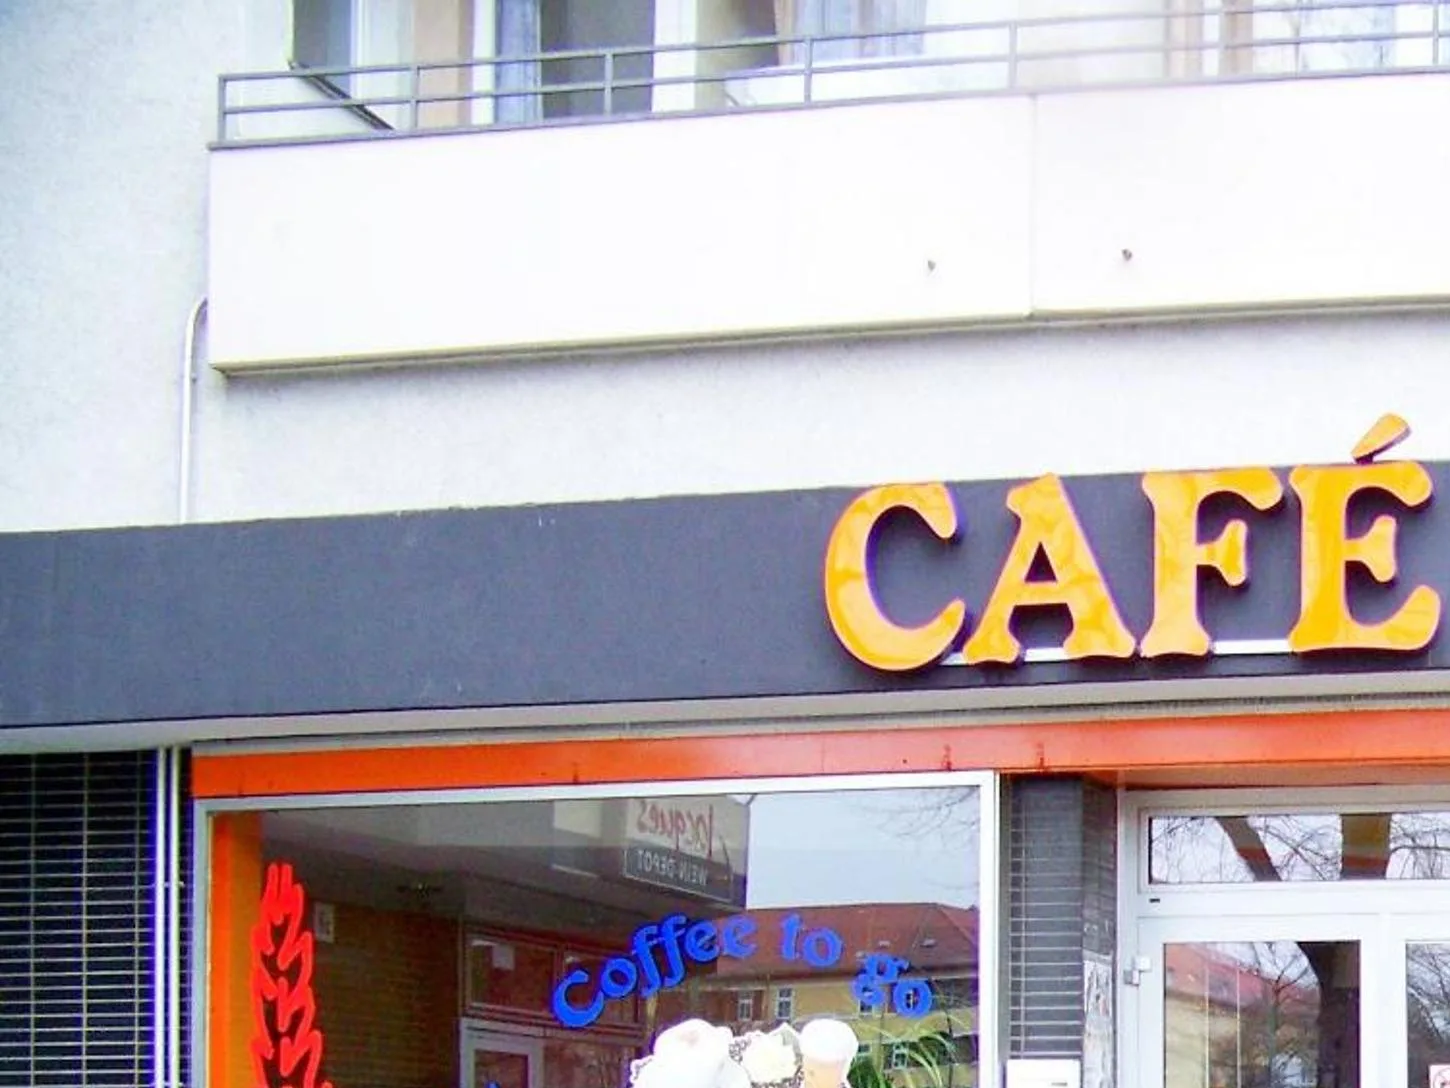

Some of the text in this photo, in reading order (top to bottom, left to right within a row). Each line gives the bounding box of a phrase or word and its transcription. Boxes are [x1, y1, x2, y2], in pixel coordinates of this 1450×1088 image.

[824, 412, 1443, 673] CAFÉ
[552, 911, 935, 1029] Coffee to go
